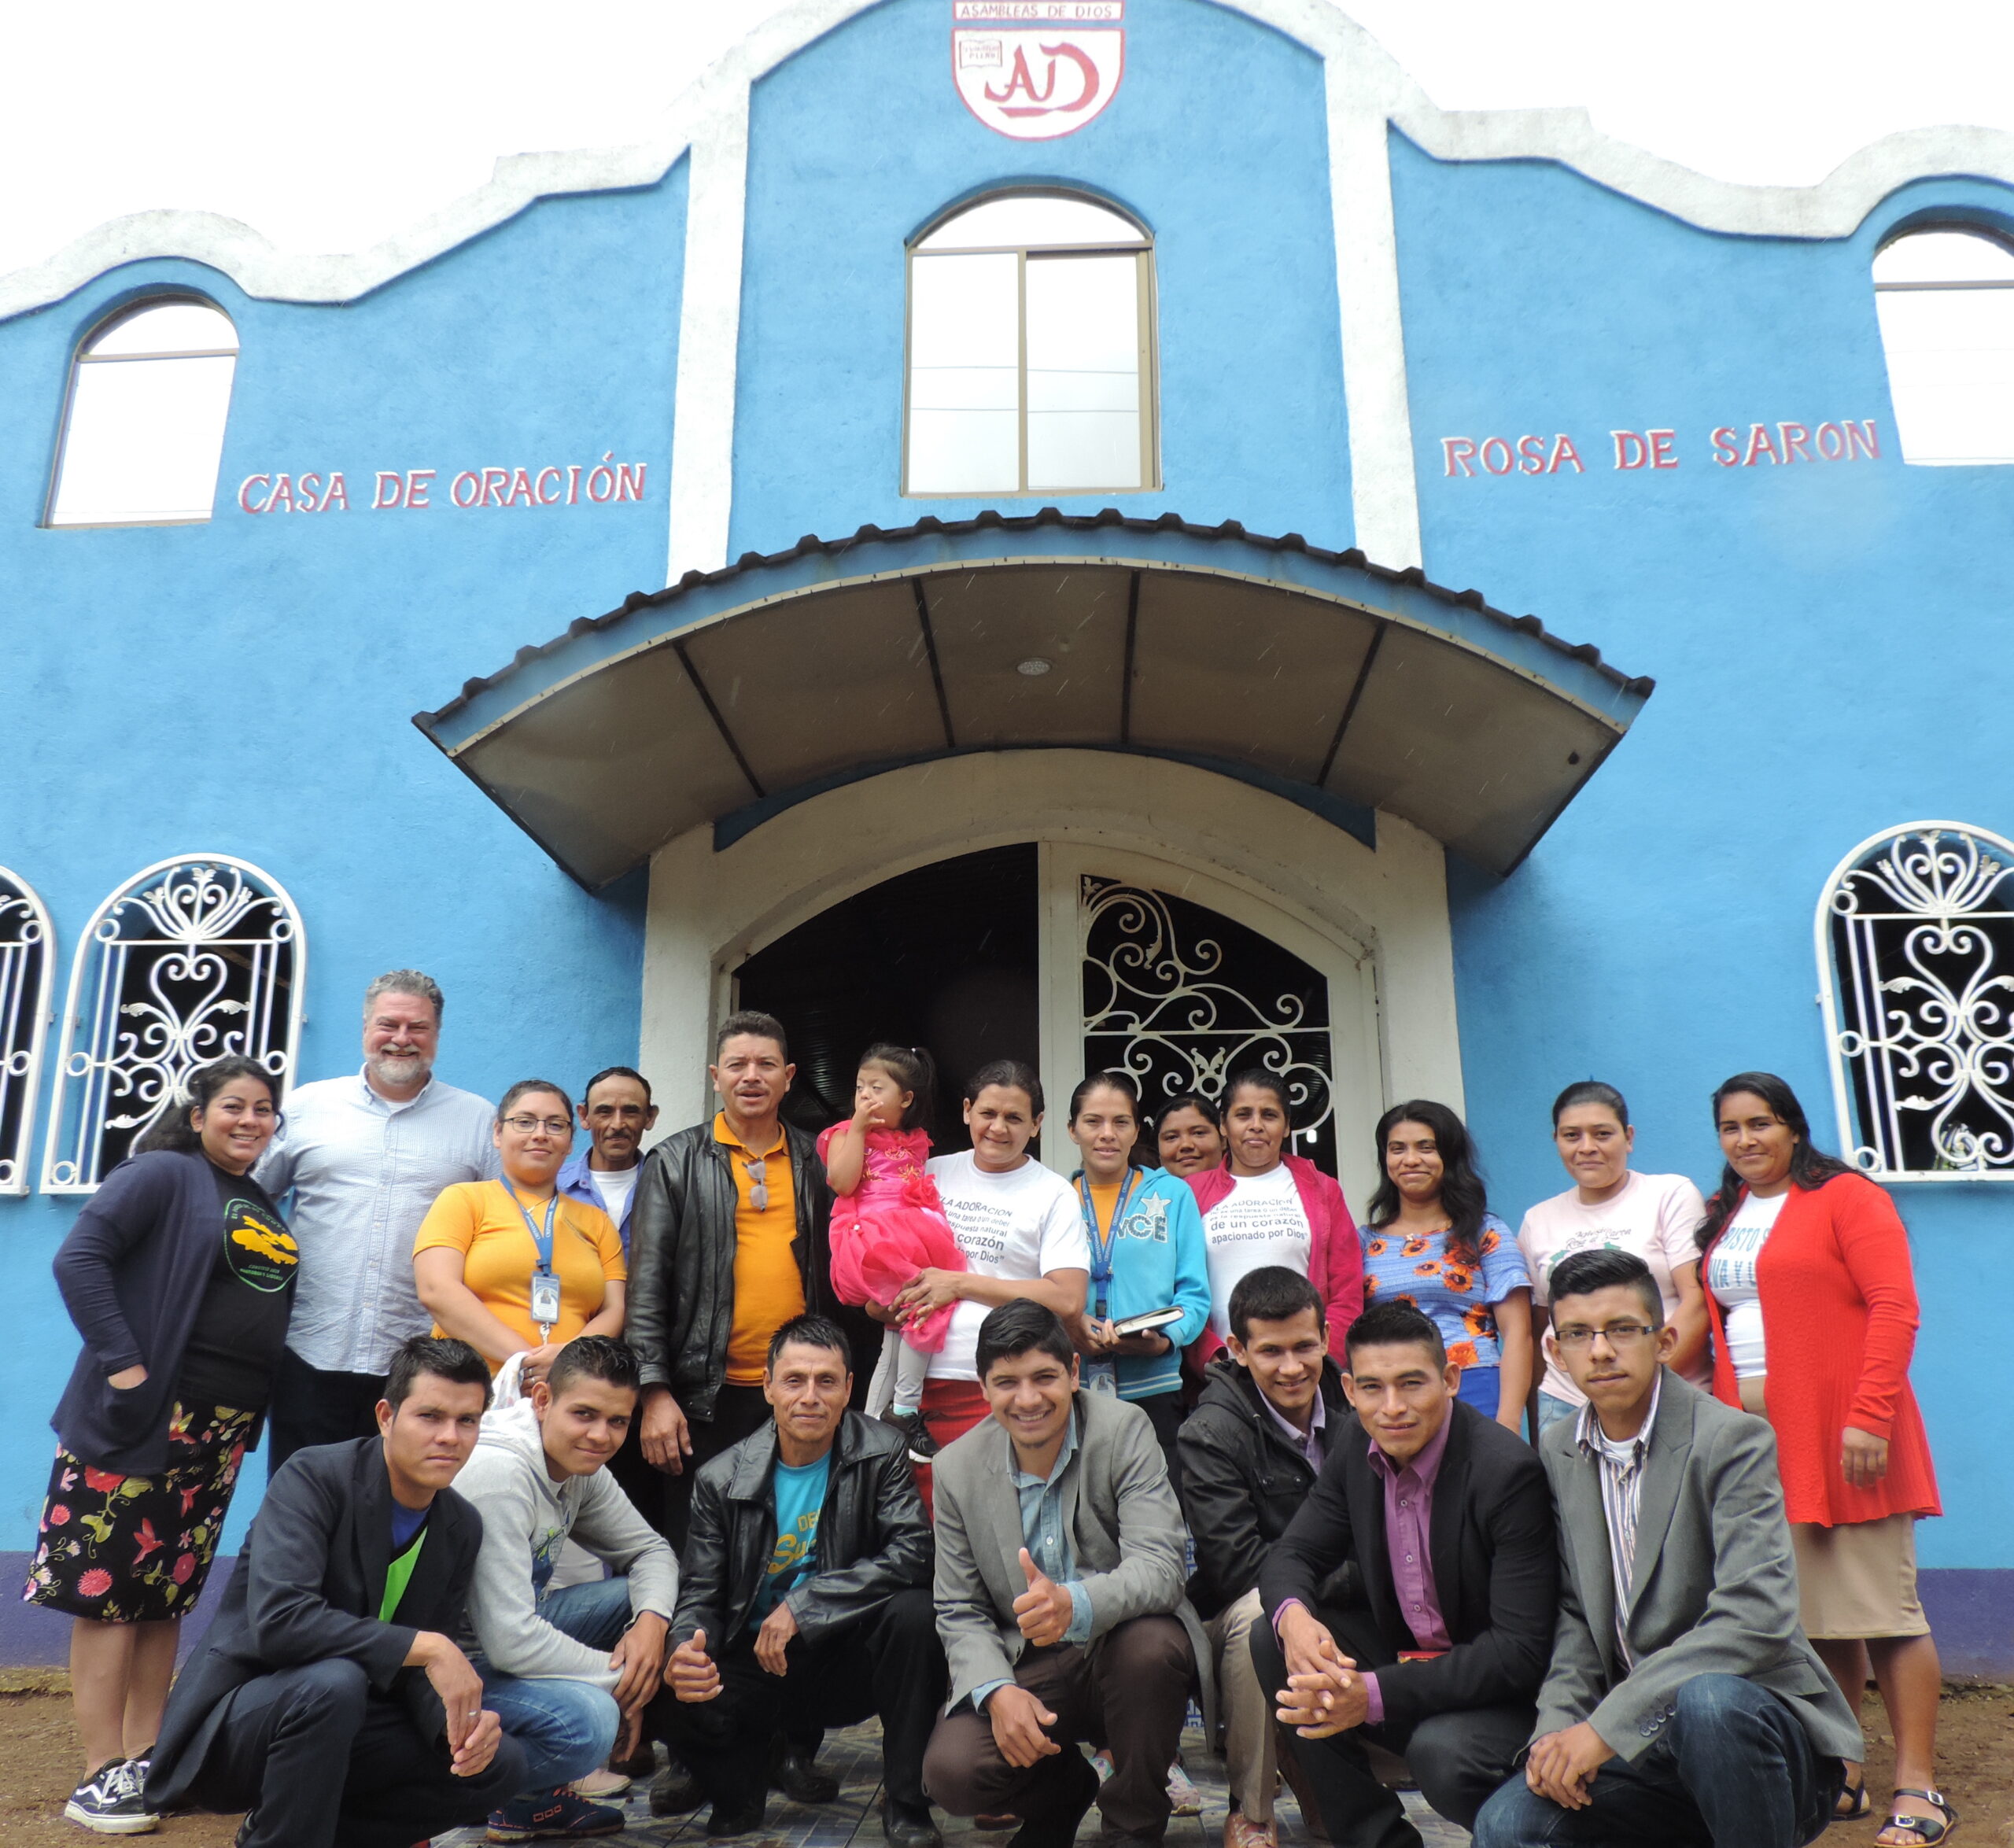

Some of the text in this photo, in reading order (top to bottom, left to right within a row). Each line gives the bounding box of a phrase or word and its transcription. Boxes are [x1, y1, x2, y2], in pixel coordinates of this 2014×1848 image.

[961, 4, 1112, 18] ASAMBLEAS DE DIOS
[1440, 419, 1881, 478] ROSA DE SARON
[238, 451, 647, 515] CASA DE ORACIÓN
[954, 1201, 1013, 1218] ADORACION
[947, 1220, 979, 1232] espuesta
[1211, 1220, 1226, 1231] de
[957, 1233, 1005, 1251] corazón
[1212, 1230, 1265, 1245] apacionado
[1268, 1229, 1284, 1241] por
[1719, 1227, 1761, 1252] RISTO
[965, 1250, 979, 1259] por
